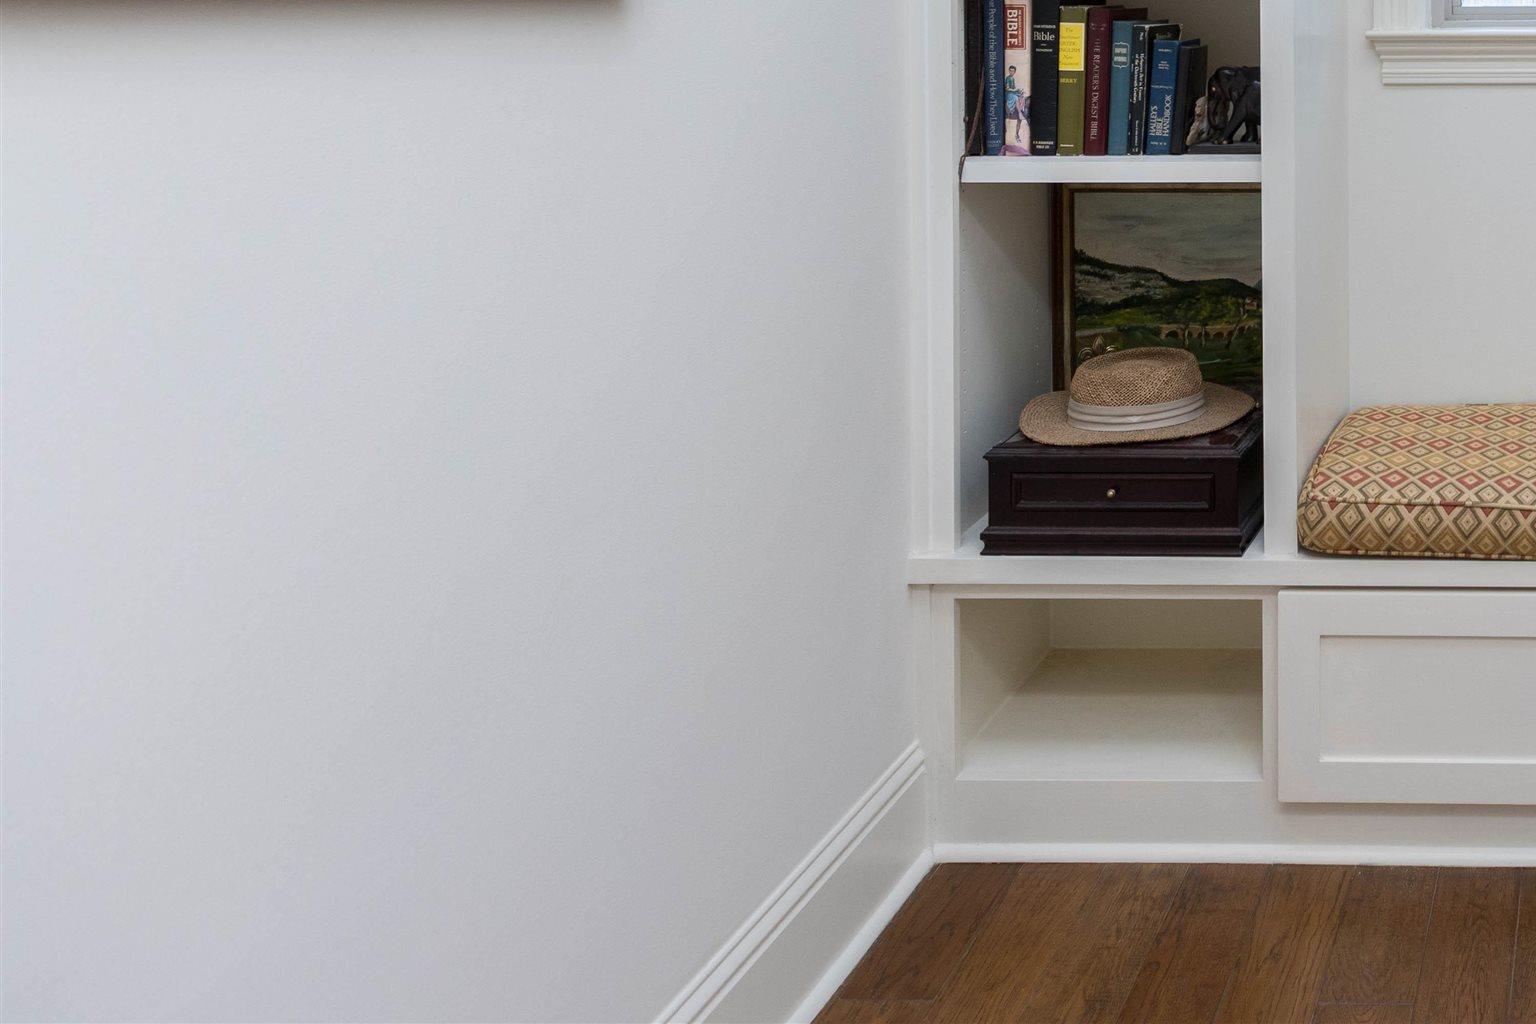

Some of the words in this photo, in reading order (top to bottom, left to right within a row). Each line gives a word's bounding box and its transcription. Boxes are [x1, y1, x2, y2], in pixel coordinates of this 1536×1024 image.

[987, 8, 997, 30] People
[989, 30, 997, 38] of
[1007, 9, 1018, 47] BIBLE
[1033, 31, 1055, 41] Bible
[989, 39, 997, 49] the
[989, 51, 997, 68] Bible
[989, 68, 997, 82] and
[989, 83, 997, 98] How
[988, 99, 997, 117] They
[1091, 92, 1099, 119] DIGEST
[989, 117, 997, 136] Lived
